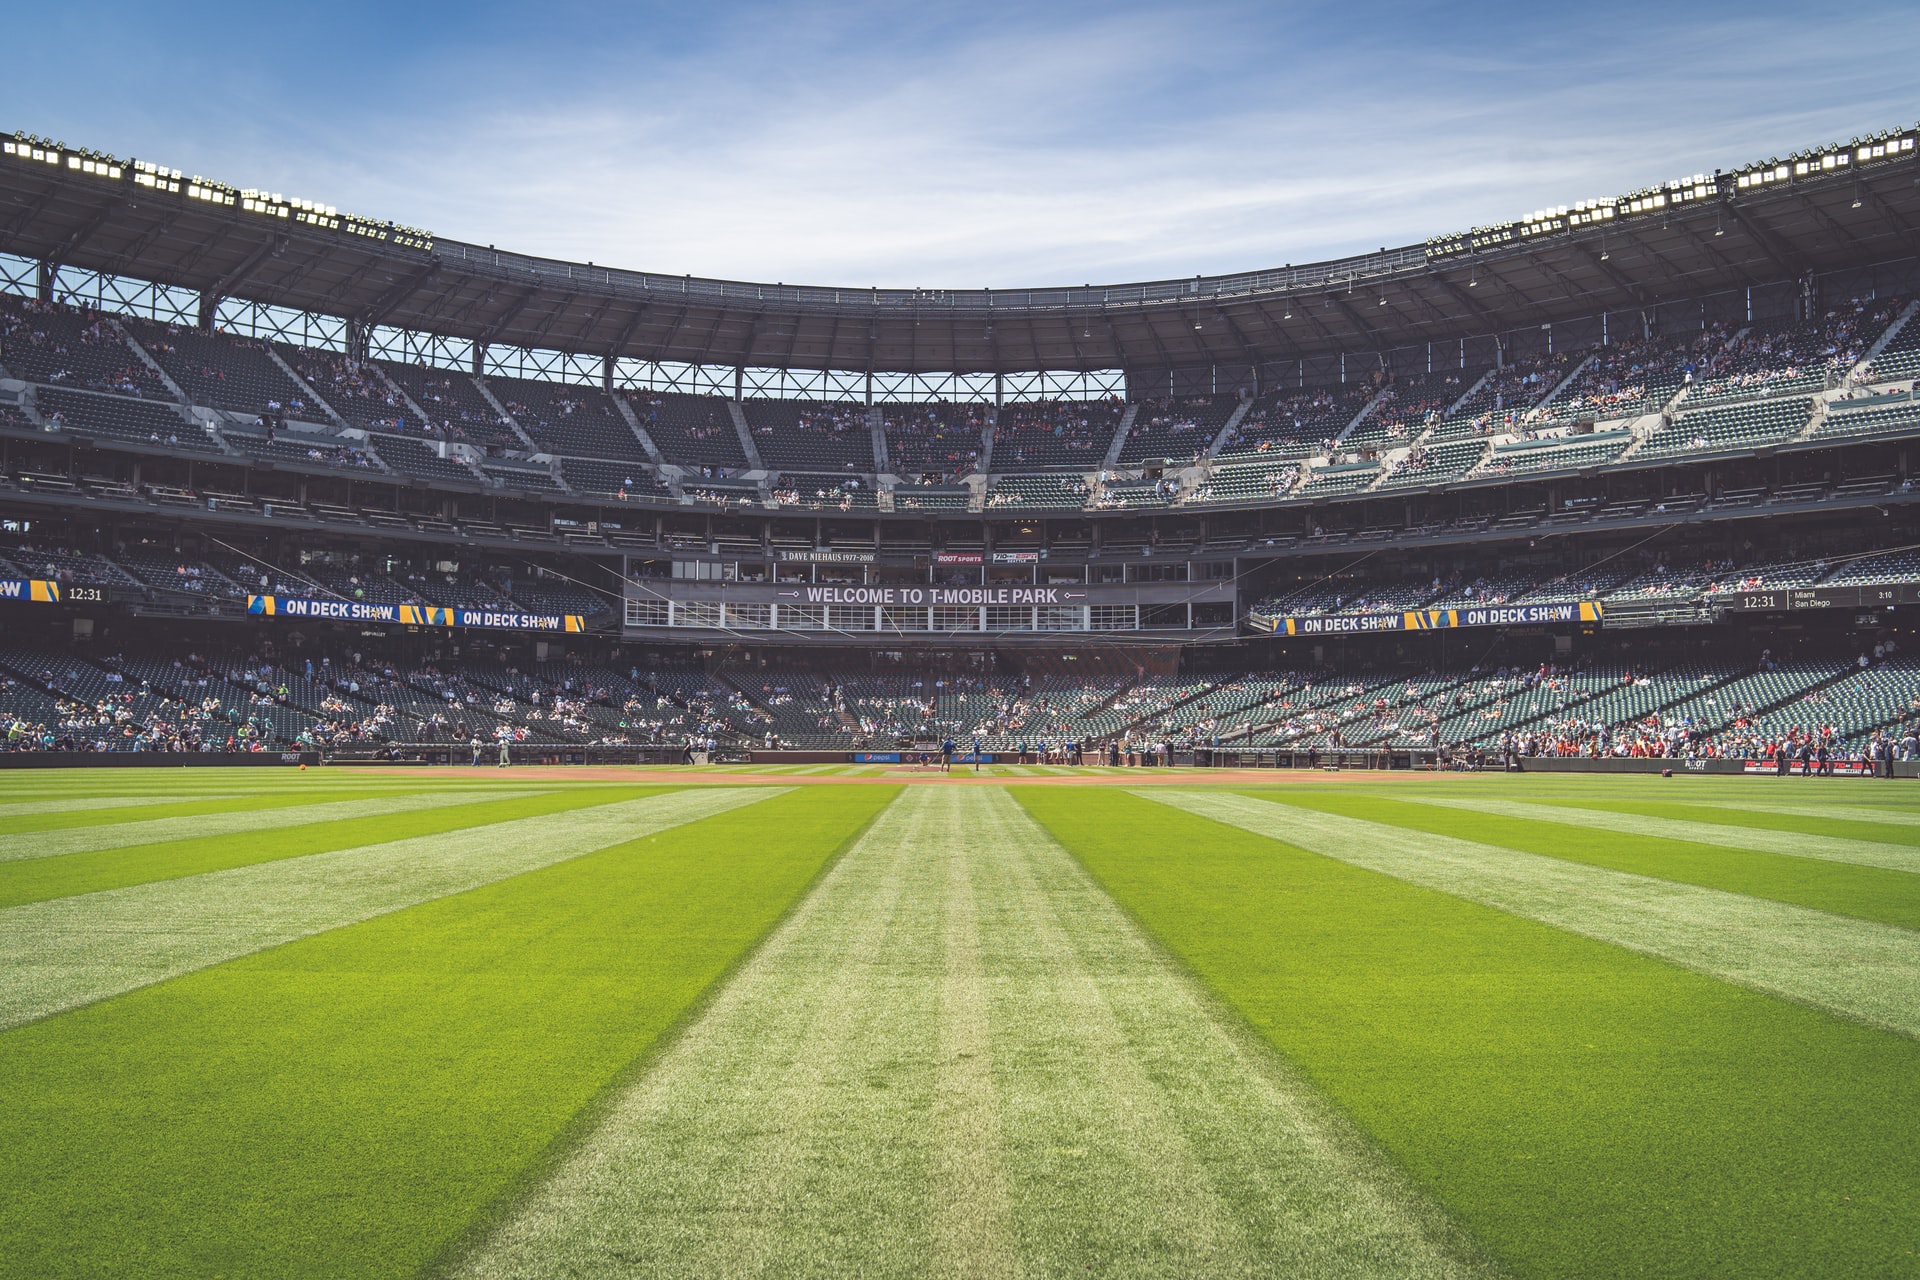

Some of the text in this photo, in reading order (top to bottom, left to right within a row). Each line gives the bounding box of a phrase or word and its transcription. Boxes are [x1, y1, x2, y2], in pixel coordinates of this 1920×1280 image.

[789, 552, 874, 562] DAVE NIEHAUS 1977-2010
[69, 587, 102, 601] 12:31
[807, 587, 1058, 604] WELCOME TO T-MOBILE PARK
[1794, 591, 1815, 599] Miami
[1878, 591, 1893, 599] 3:10
[1743, 595, 1775, 608] 12:31
[1794, 599, 1831, 608] San Diego
[286, 600, 307, 615] ON
[310, 601, 349, 618] DECK
[463, 611, 481, 625] ON
[484, 612, 519, 627] DECK
[1468, 610, 1487, 624] ON
[1490, 608, 1527, 623] DECK
[1304, 619, 1321, 632] ON
[1325, 617, 1359, 632] DECK
[281, 753, 301, 761] ROOT
